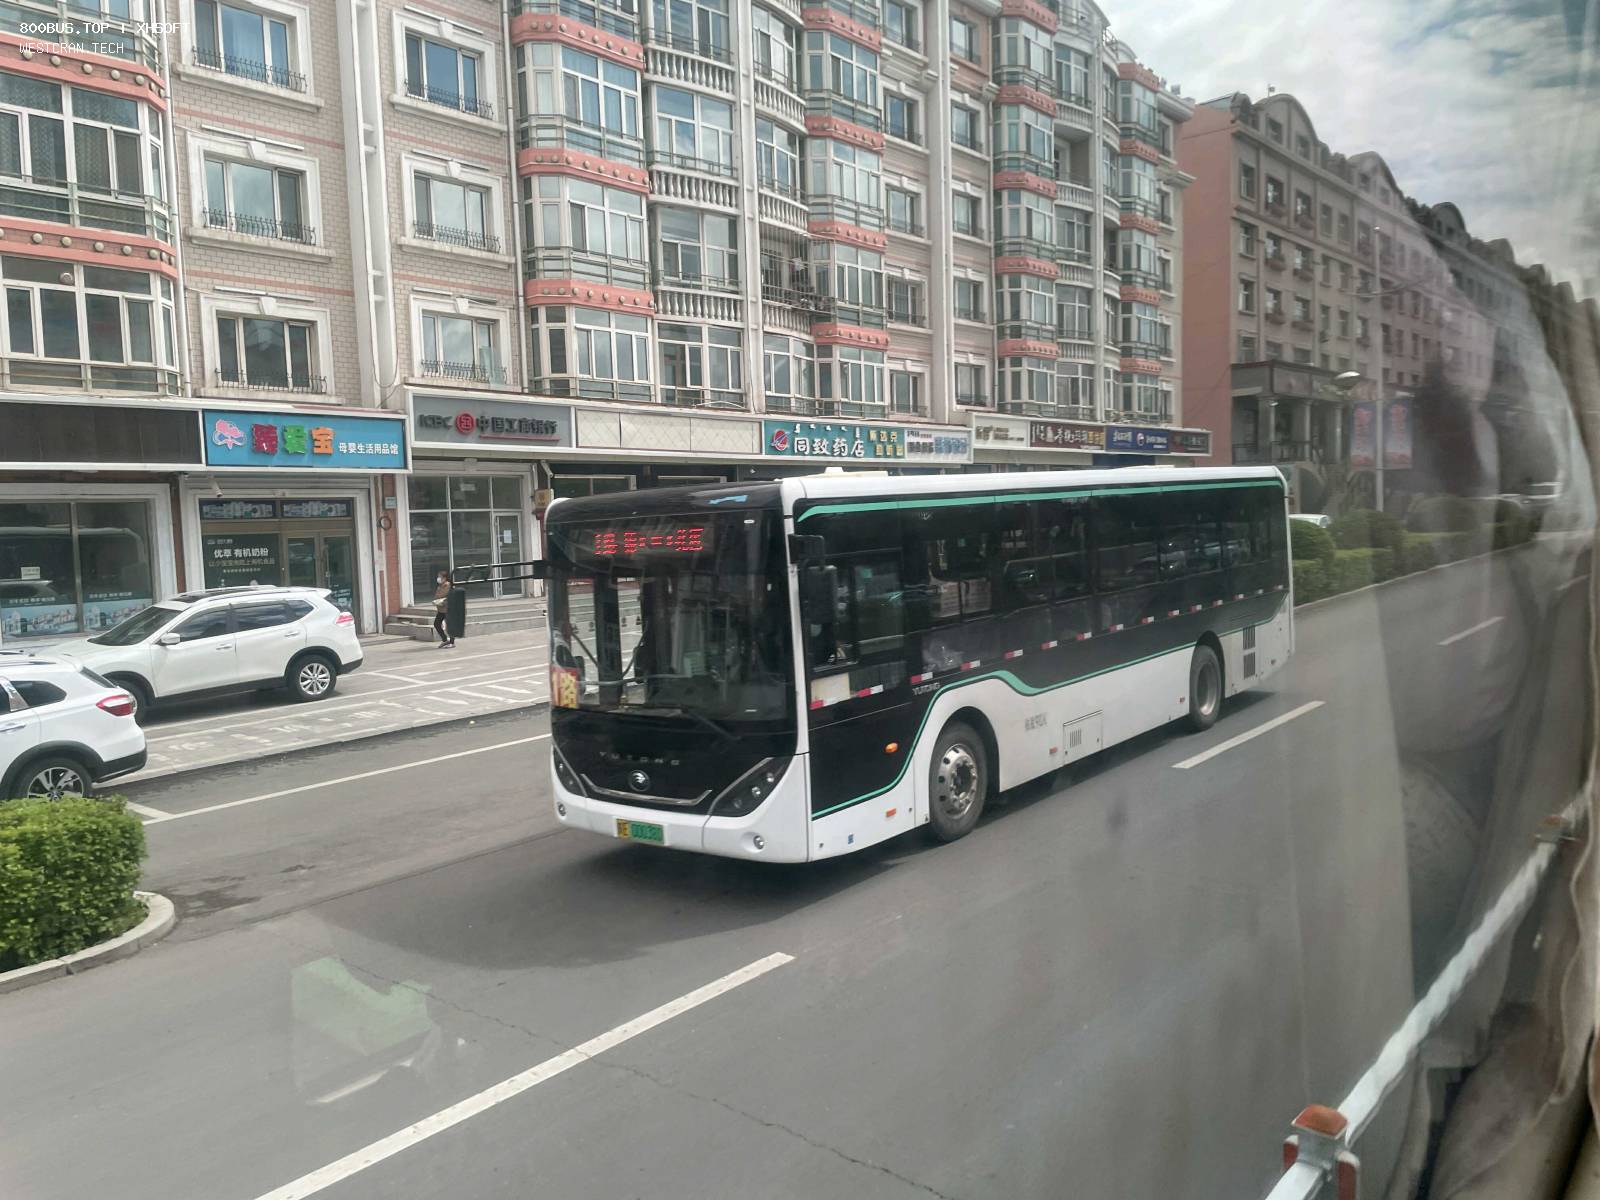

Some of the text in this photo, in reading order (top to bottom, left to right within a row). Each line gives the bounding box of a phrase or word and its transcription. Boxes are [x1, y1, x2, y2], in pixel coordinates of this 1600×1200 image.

[477, 415, 558, 435] 中国工商银行
[338, 442, 399, 456] 母婴生活用品馆
[794, 437, 866, 457] 同致药店
[234, 547, 269, 558] 有机奶粉
